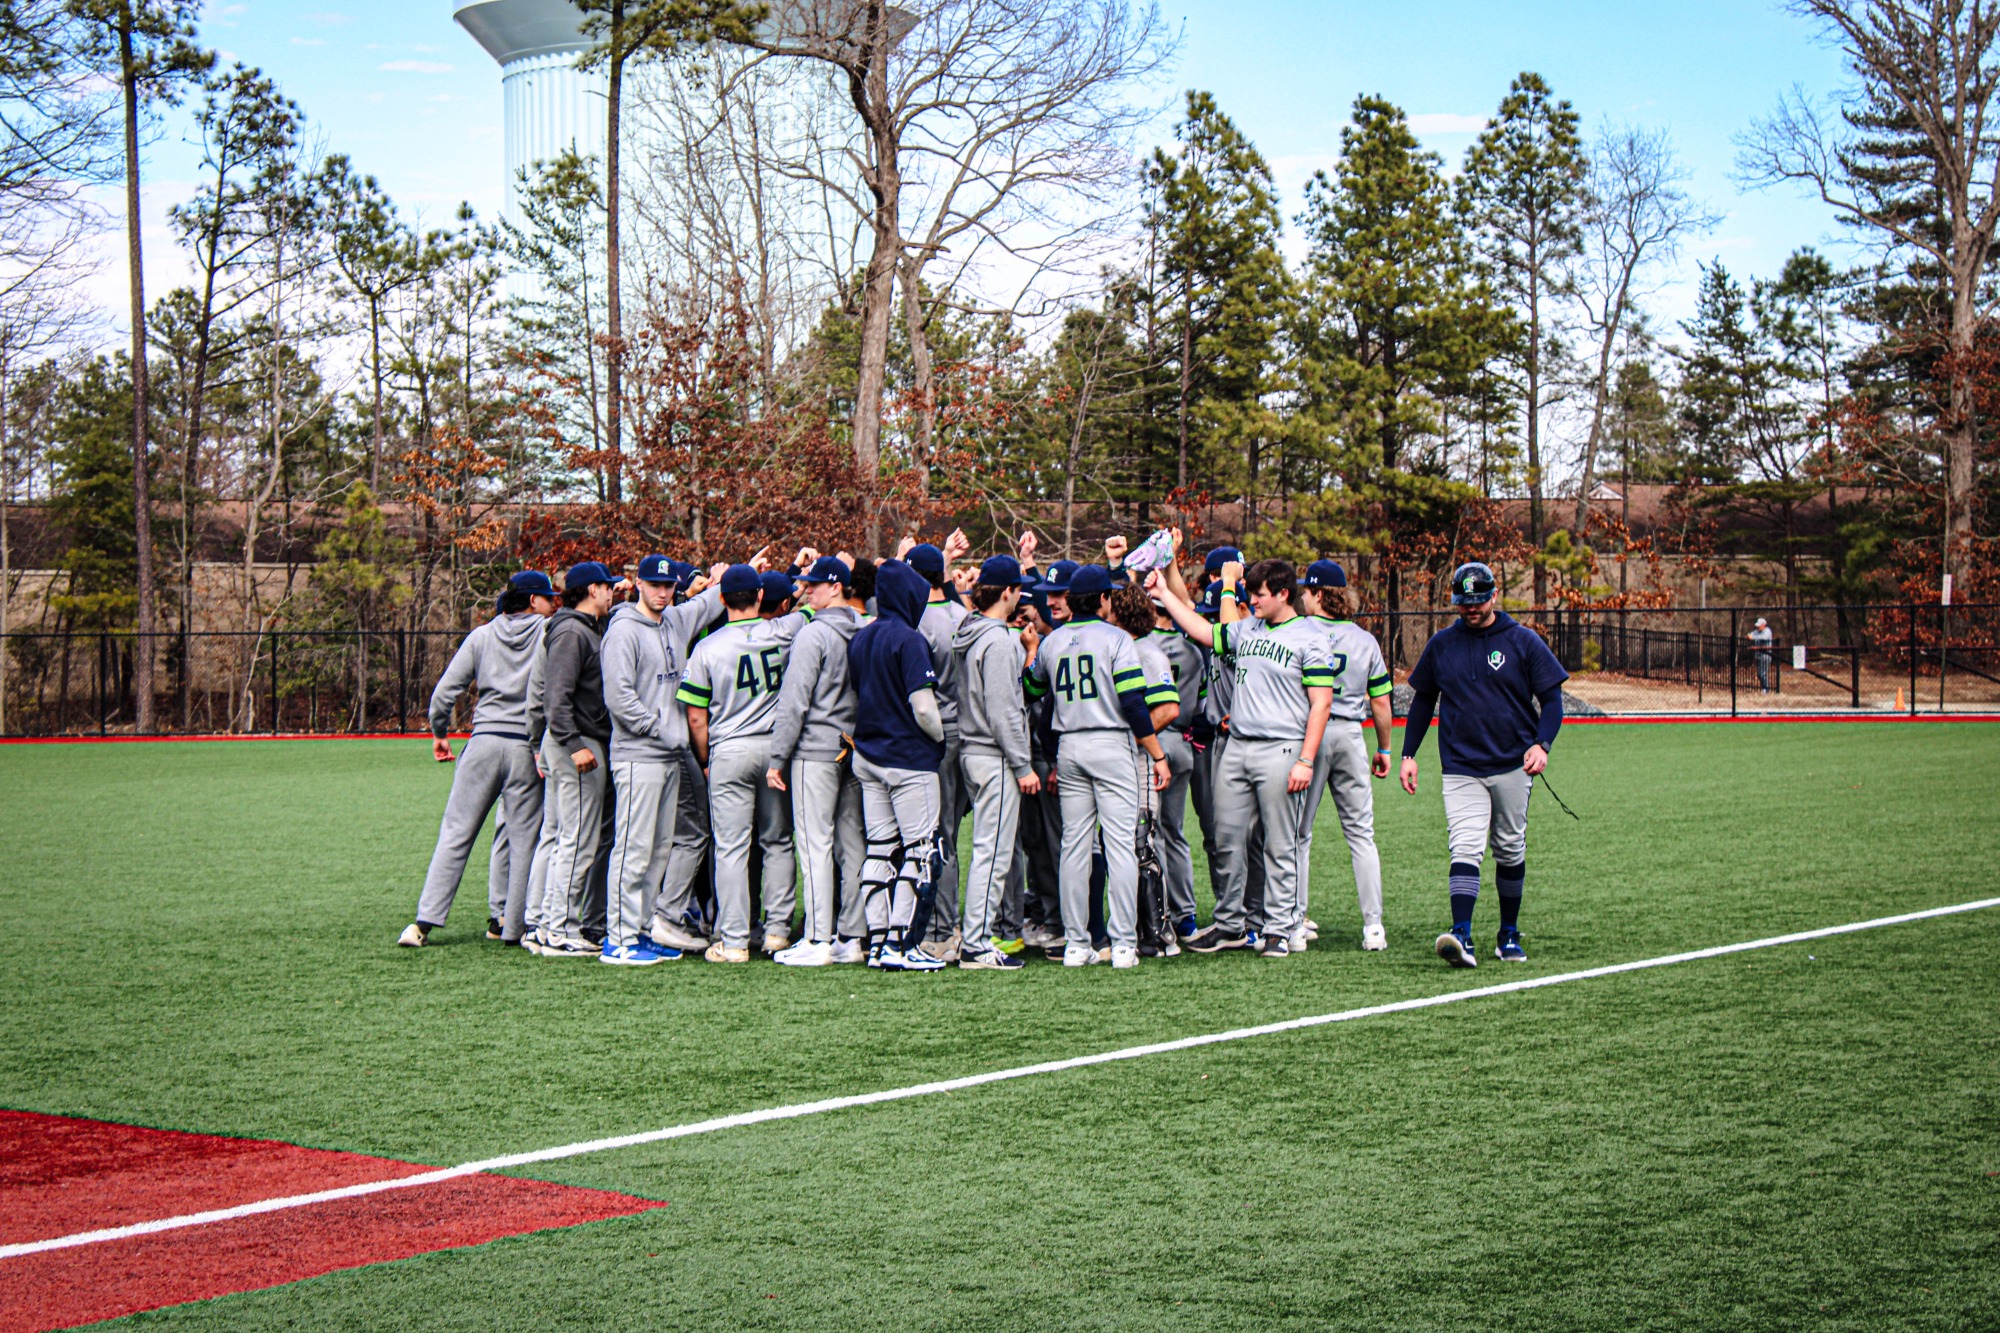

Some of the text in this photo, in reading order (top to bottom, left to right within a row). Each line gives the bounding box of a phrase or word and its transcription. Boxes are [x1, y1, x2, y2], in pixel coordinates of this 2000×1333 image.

[736, 646, 783, 699] 46
[1056, 653, 1099, 703] 48
[1238, 639, 1293, 668] ALLEGANY
